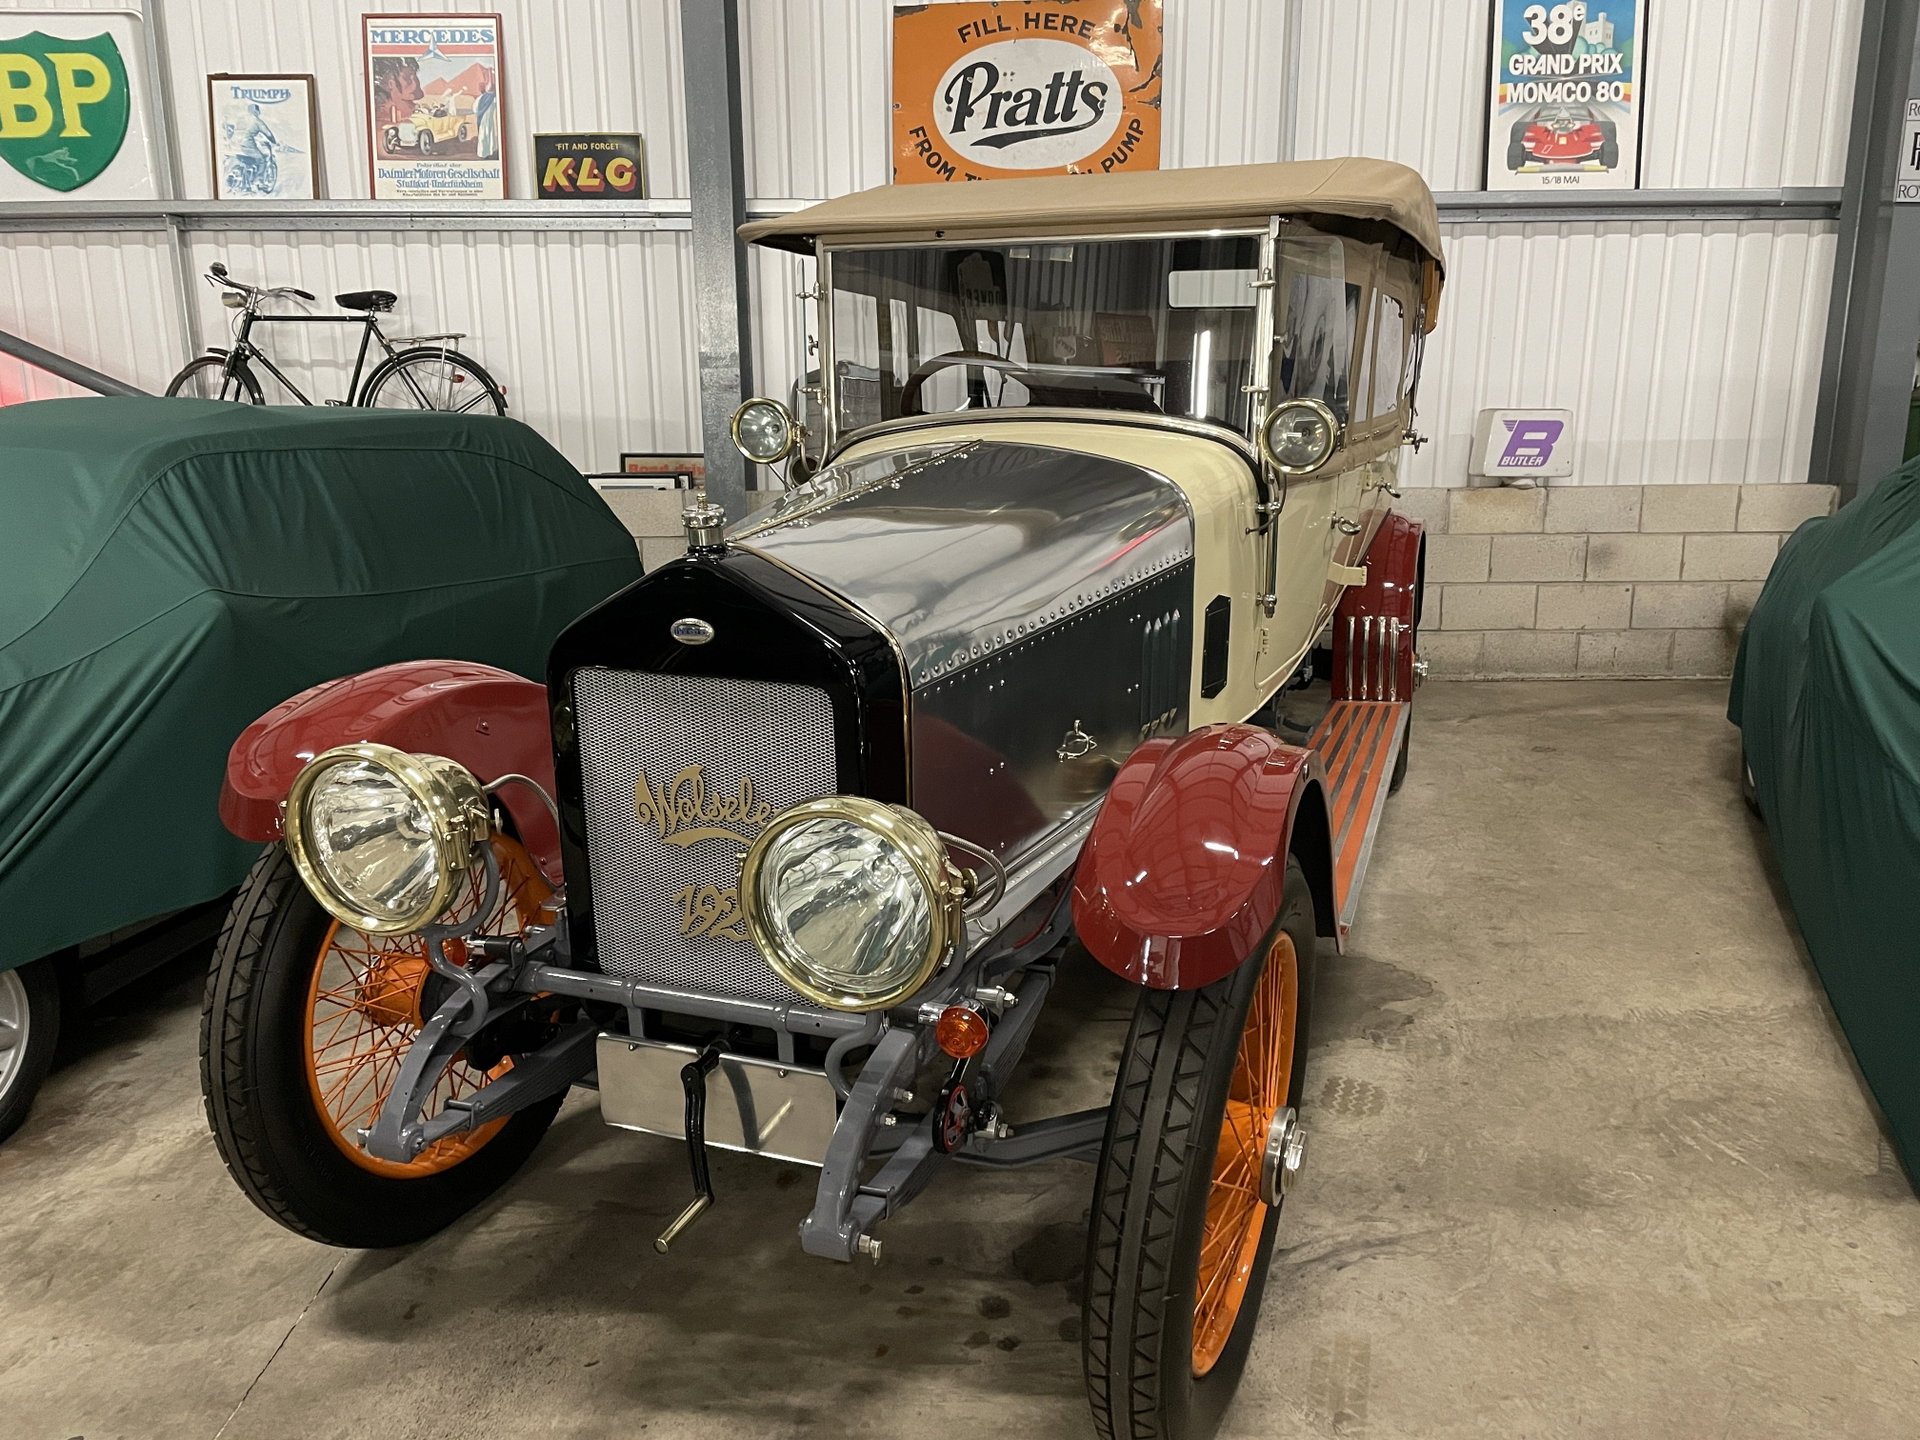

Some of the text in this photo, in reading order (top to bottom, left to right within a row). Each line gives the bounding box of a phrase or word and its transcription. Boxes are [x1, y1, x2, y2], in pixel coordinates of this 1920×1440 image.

[370, 29, 495, 44] MERCEDES
[957, 12, 1097, 44] FILL HERE
[1508, 53, 1624, 76] GRAND PRIX
[0, 53, 111, 138] BP
[230, 86, 291, 104] TRIUMPH
[944, 61, 1109, 149] Pratts
[1506, 81, 1625, 104] MONACO 80
[556, 143, 569, 151] FIT
[590, 143, 619, 151] FORGET
[909, 126, 957, 182] FROM
[1101, 118, 1145, 173] PUMP
[1541, 175, 1580, 185] 15/18 MAI
[1501, 457, 1543, 466] BUTLER
[634, 764, 778, 839] Wolsele
[672, 884, 751, 943] 192
